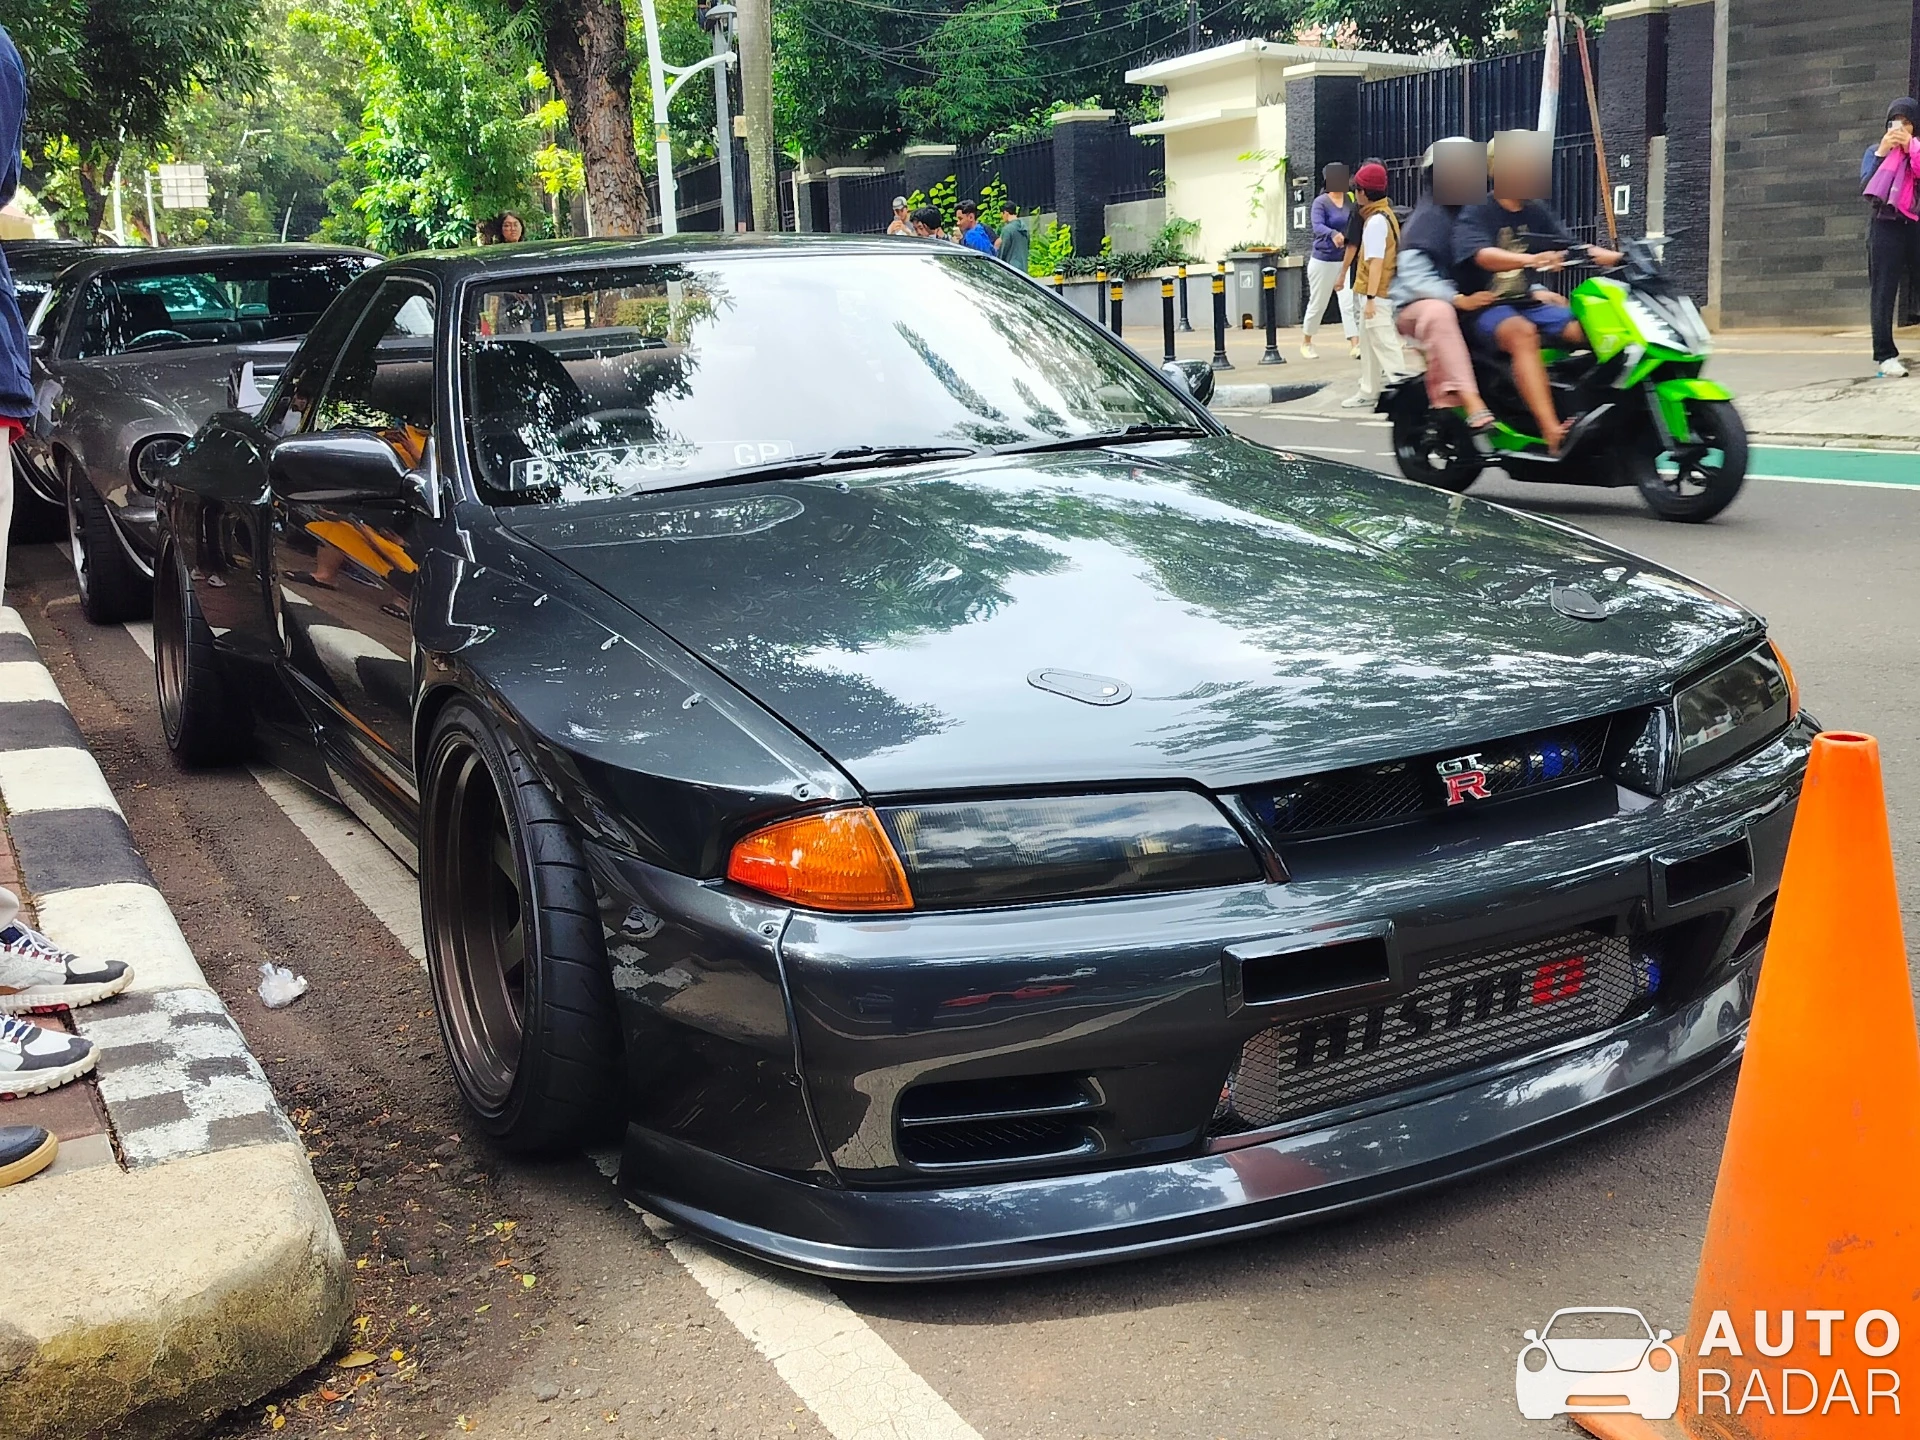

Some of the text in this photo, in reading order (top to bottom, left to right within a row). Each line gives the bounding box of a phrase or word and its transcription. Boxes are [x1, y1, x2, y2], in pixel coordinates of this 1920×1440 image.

[1620, 154, 1631, 168] 16
[1293, 189, 1303, 202] 16
[526, 460, 549, 487] B
[733, 442, 780, 466] GP
